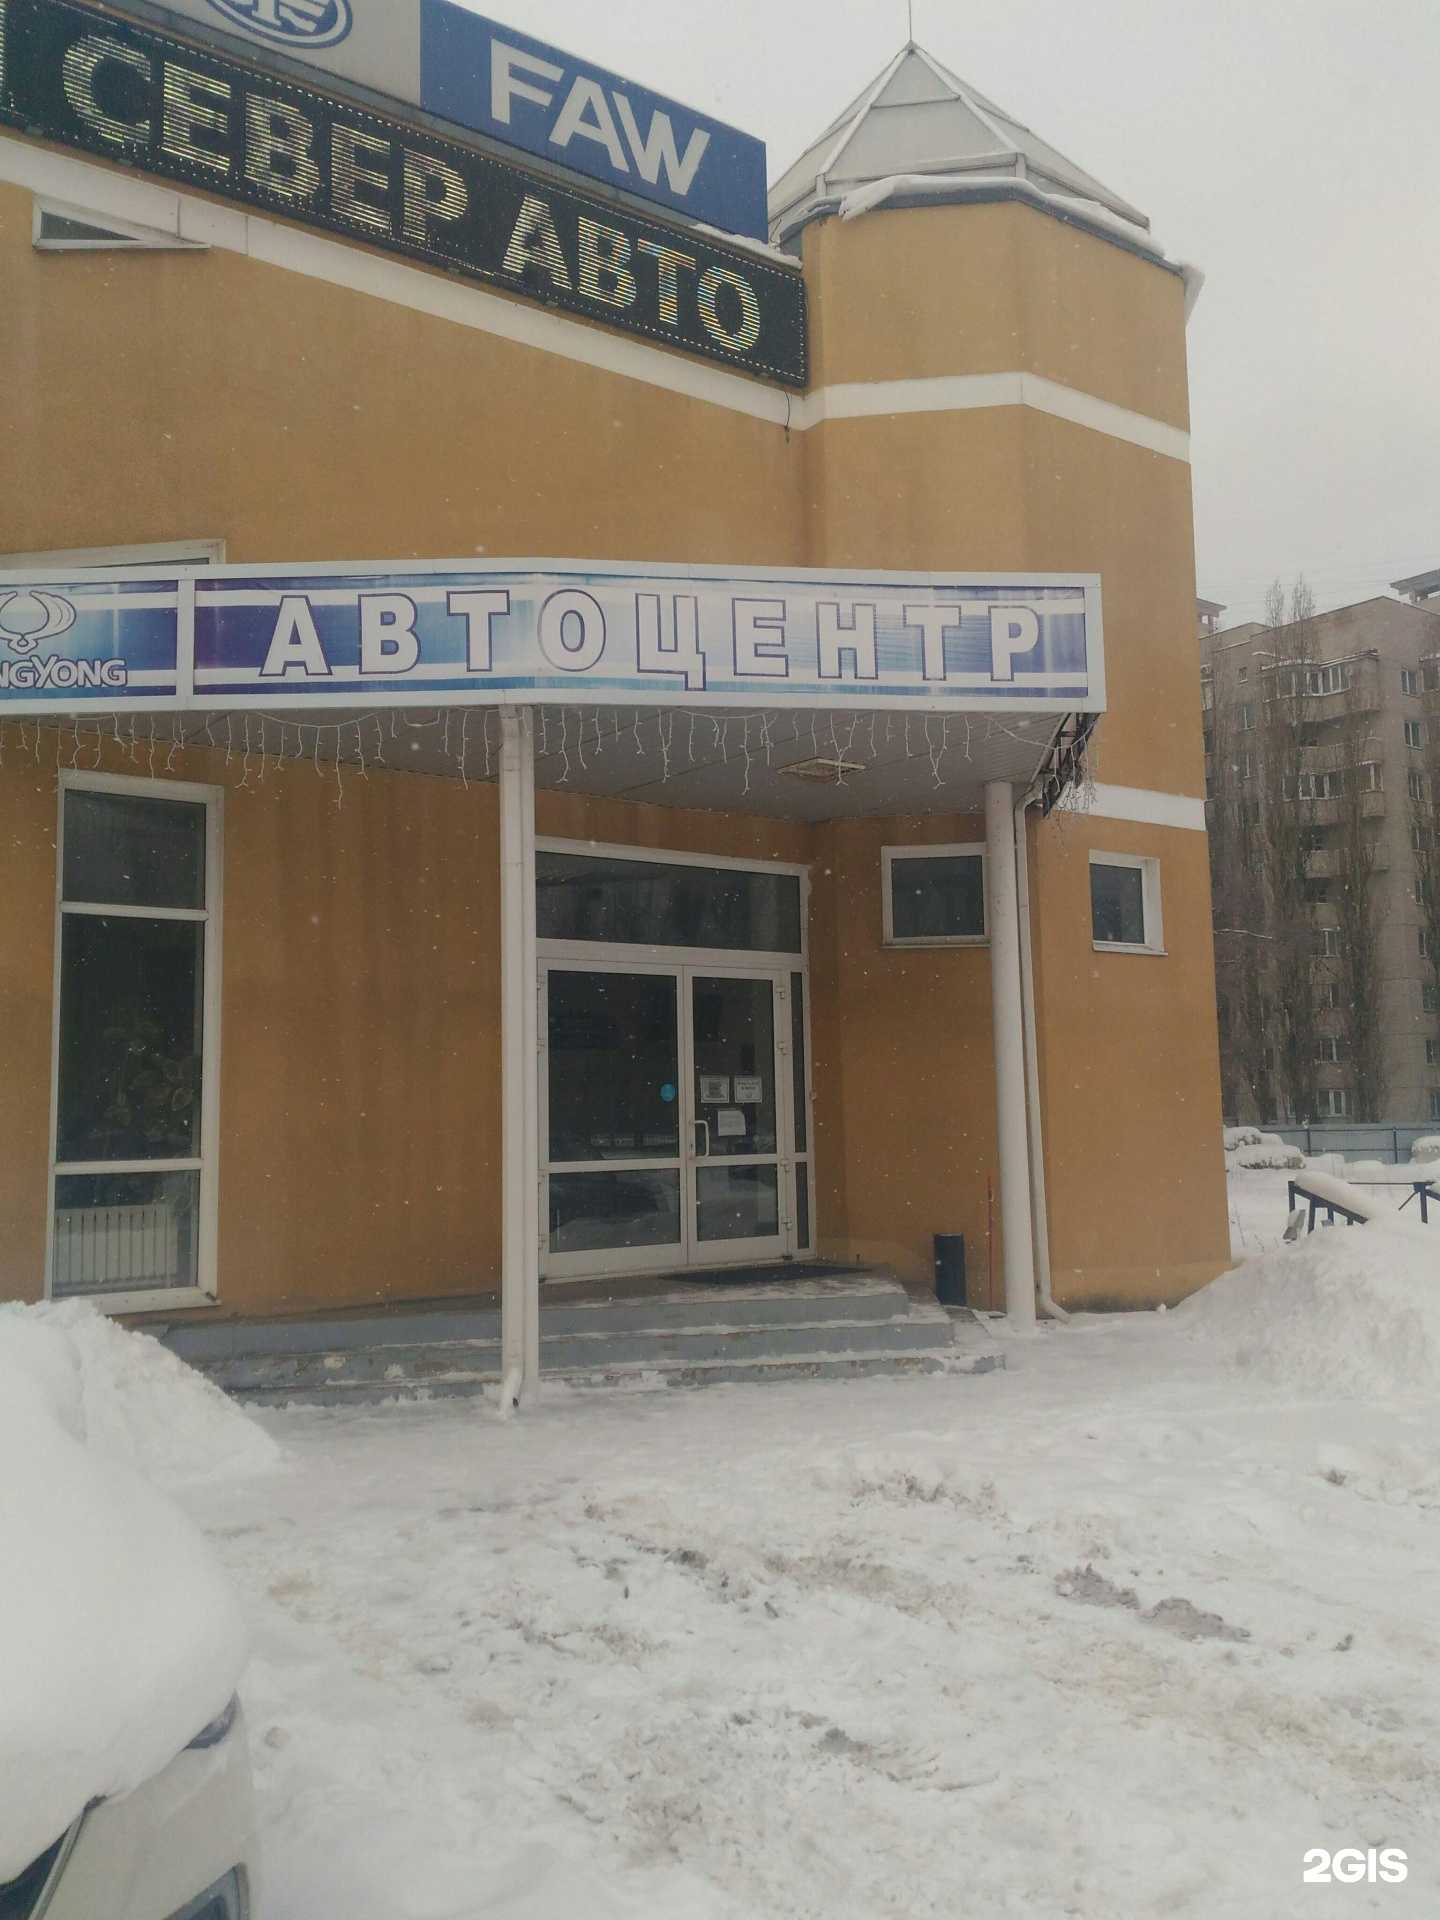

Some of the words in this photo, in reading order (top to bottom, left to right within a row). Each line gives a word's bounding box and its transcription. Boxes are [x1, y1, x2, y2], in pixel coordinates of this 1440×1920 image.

[62, 34, 469, 242] СЕВЕР
[502, 194, 762, 353] АВТО
[490, 37, 711, 196] FAW
[259, 588, 1040, 692] АВТОЦЕНТР
